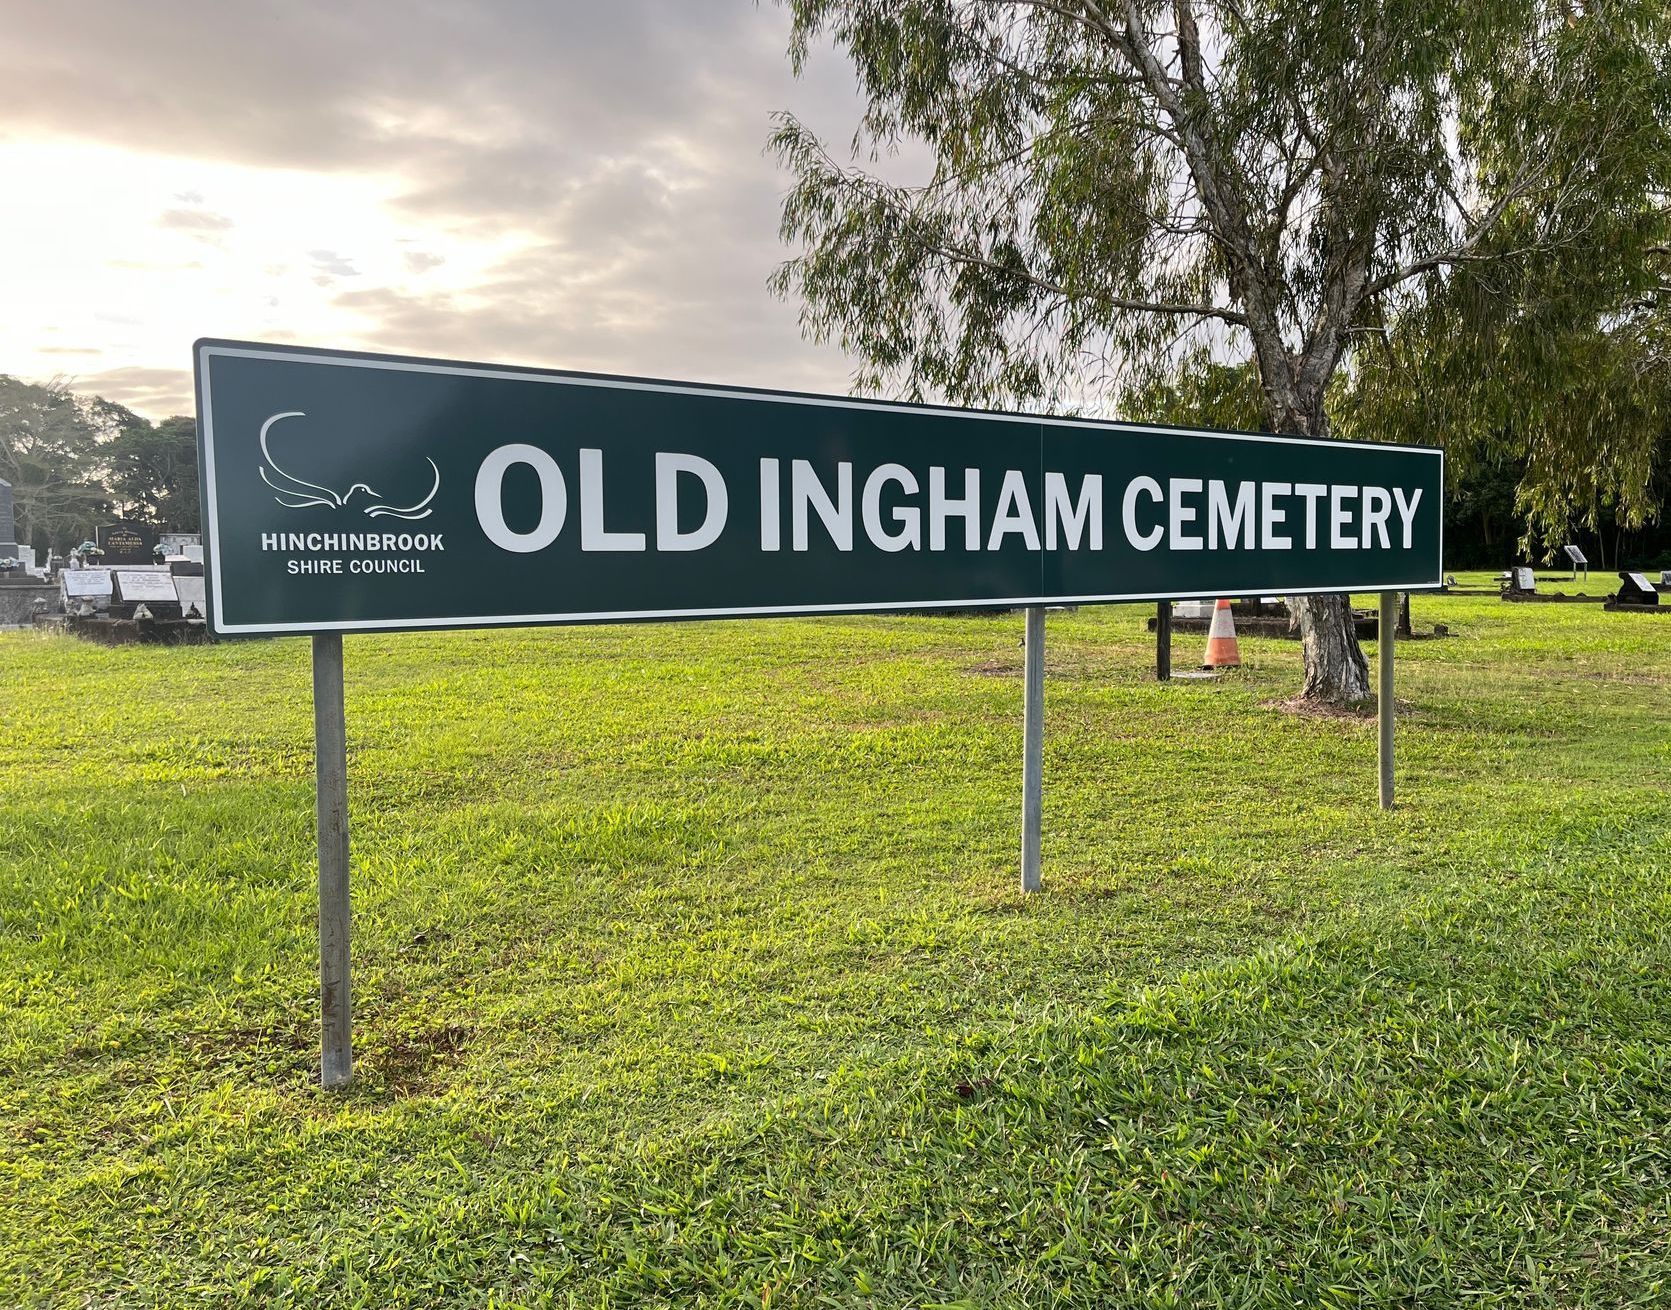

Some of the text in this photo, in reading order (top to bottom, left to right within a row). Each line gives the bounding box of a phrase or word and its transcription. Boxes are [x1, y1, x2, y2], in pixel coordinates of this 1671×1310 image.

[474, 443, 1423, 553] OLD INGHAM CEMETERY
[261, 532, 445, 552] HINCHINBROOK
[287, 559, 426, 575] SHIRE COUNCIL
